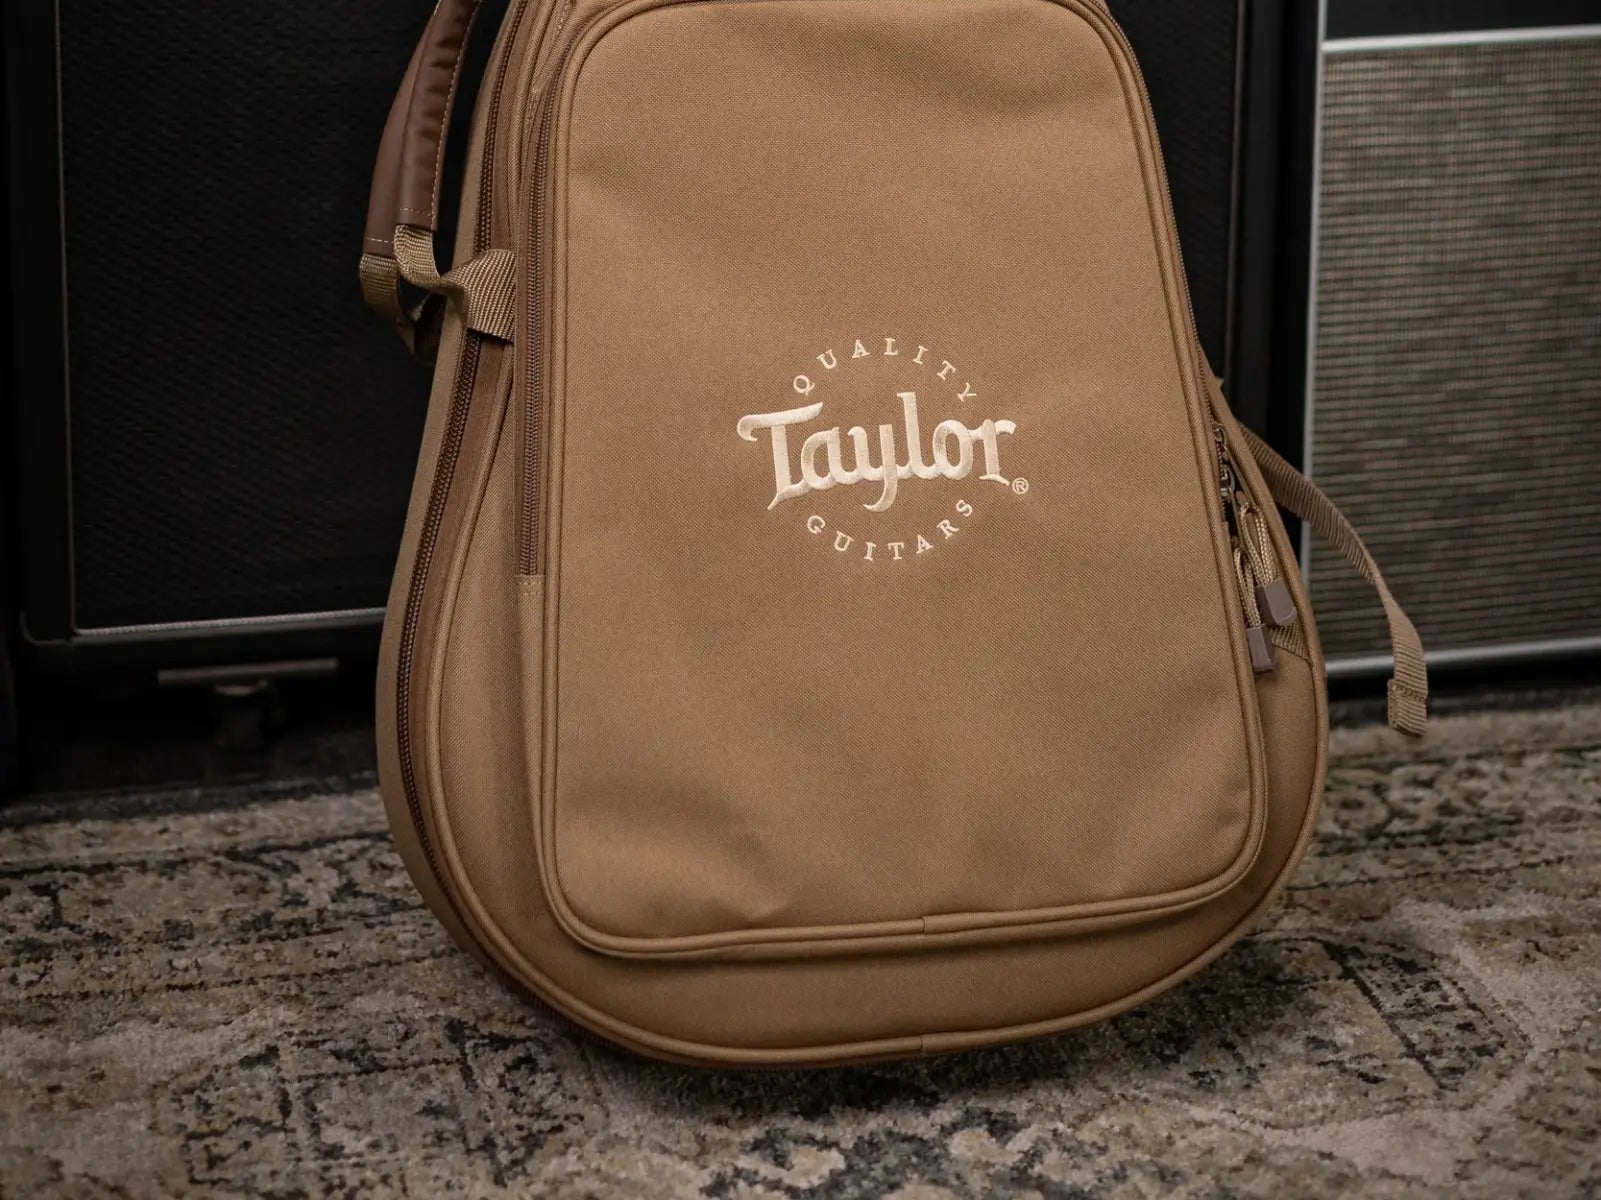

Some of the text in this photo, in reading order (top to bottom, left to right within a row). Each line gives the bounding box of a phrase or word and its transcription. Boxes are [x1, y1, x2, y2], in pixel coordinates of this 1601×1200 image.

[792, 337, 977, 403] QUALITY
[736, 391, 1017, 513] Taylor
[806, 499, 974, 562] GUITARS
